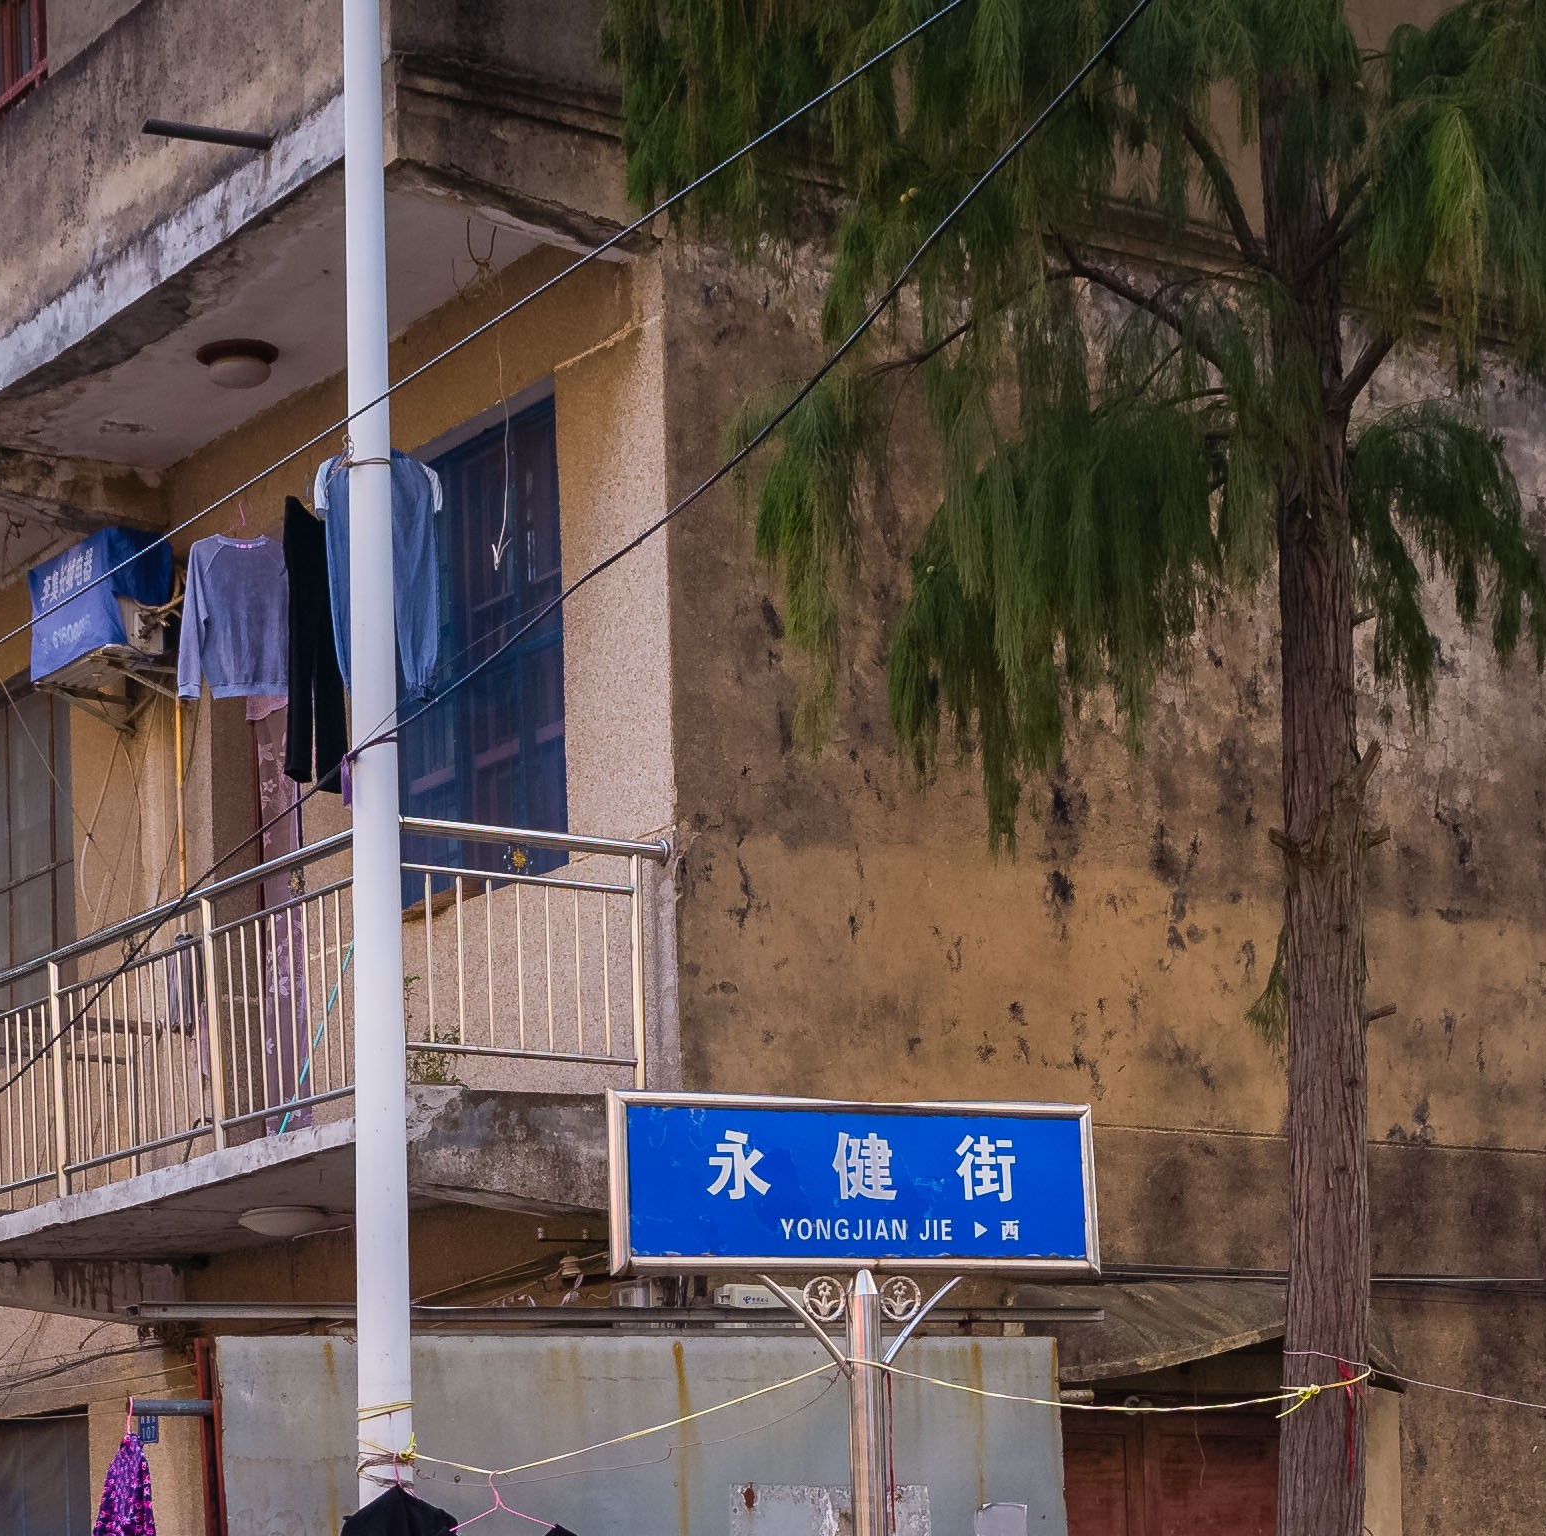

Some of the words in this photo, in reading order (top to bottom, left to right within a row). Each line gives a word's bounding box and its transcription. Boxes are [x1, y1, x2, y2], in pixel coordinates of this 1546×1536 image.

[707, 1129, 1017, 1202] 永健街
[780, 1218, 907, 1241] YONGJIAN
[919, 1218, 953, 1241] JIE
[1000, 1219, 1020, 1242] 西
